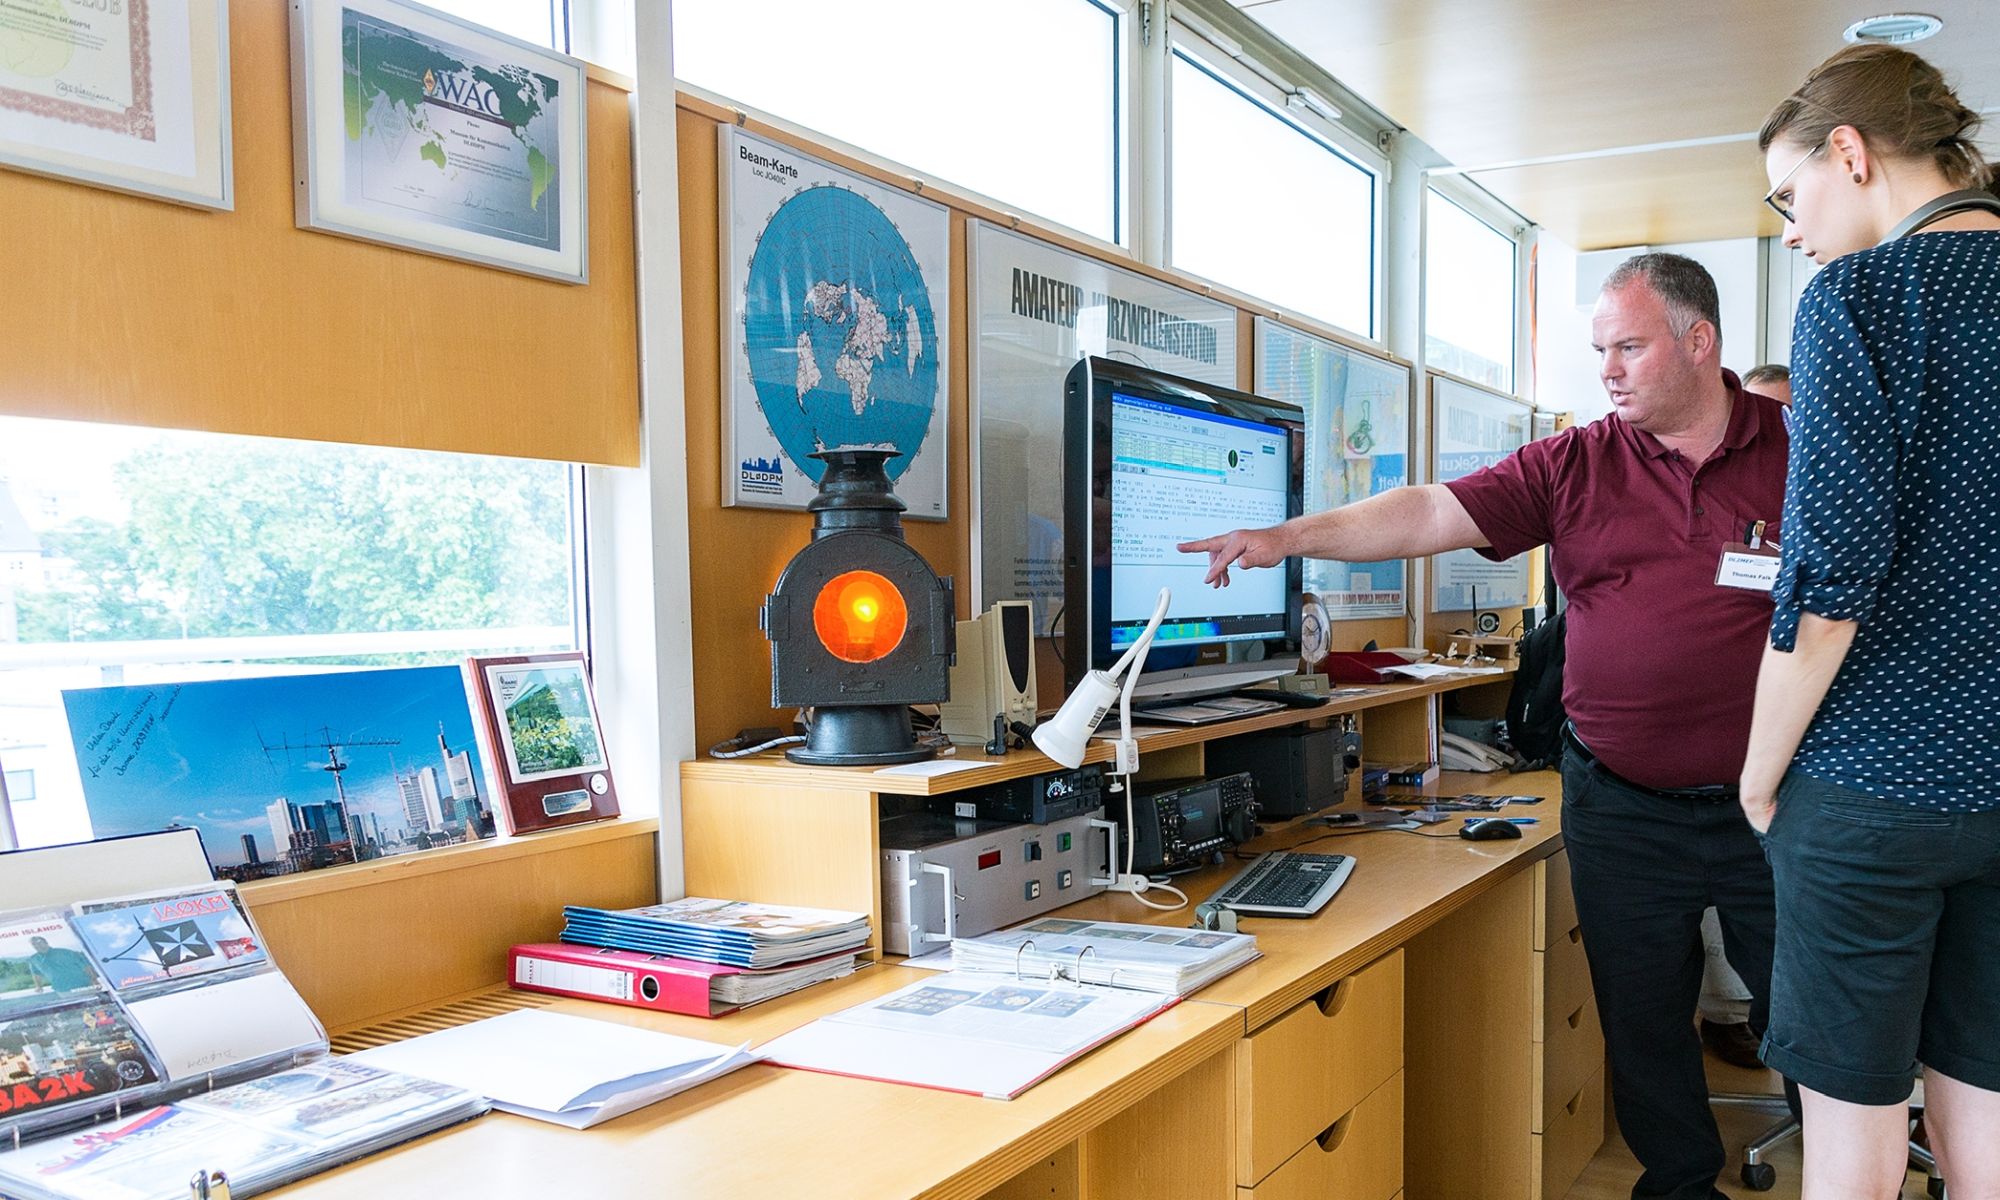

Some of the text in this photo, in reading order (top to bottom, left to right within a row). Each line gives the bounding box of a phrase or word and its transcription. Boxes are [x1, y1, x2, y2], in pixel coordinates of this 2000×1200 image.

[740, 145, 799, 179] Beam-Karte
[752, 166, 764, 178] Loc
[1011, 267, 1084, 330] AMATEUR
[21, 924, 63, 936] ISLANDS
